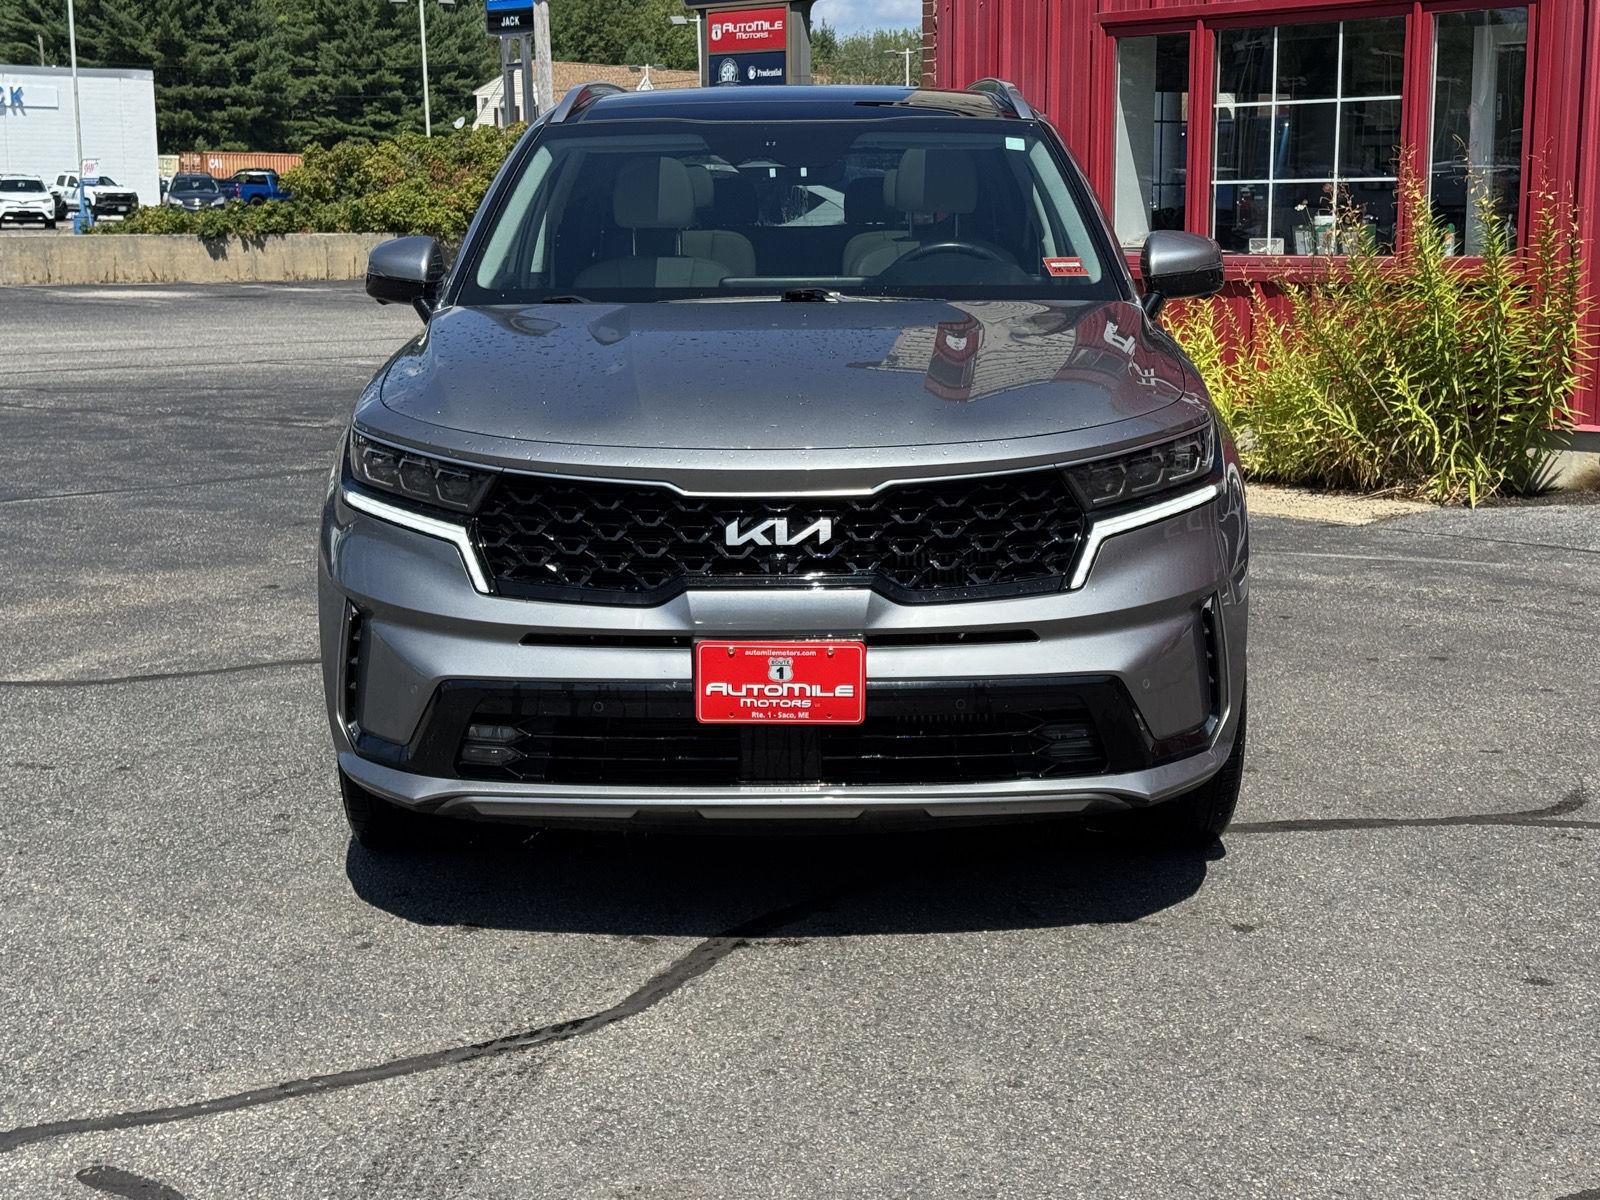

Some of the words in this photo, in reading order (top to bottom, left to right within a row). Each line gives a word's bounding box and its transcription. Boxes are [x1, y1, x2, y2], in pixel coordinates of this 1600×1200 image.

[501, 16, 520, 27] JACK
[736, 32, 768, 40] MOTORS
[757, 68, 782, 77] Prudential
[725, 517, 832, 546] KIA
[744, 649, 817, 657] automilemotors.com
[776, 666, 784, 680] 1
[740, 698, 811, 708] MOTORS
[751, 711, 766, 719] Rte.
[767, 711, 772, 719] 1
[777, 711, 797, 720] Saco,
[798, 711, 810, 719] ME
